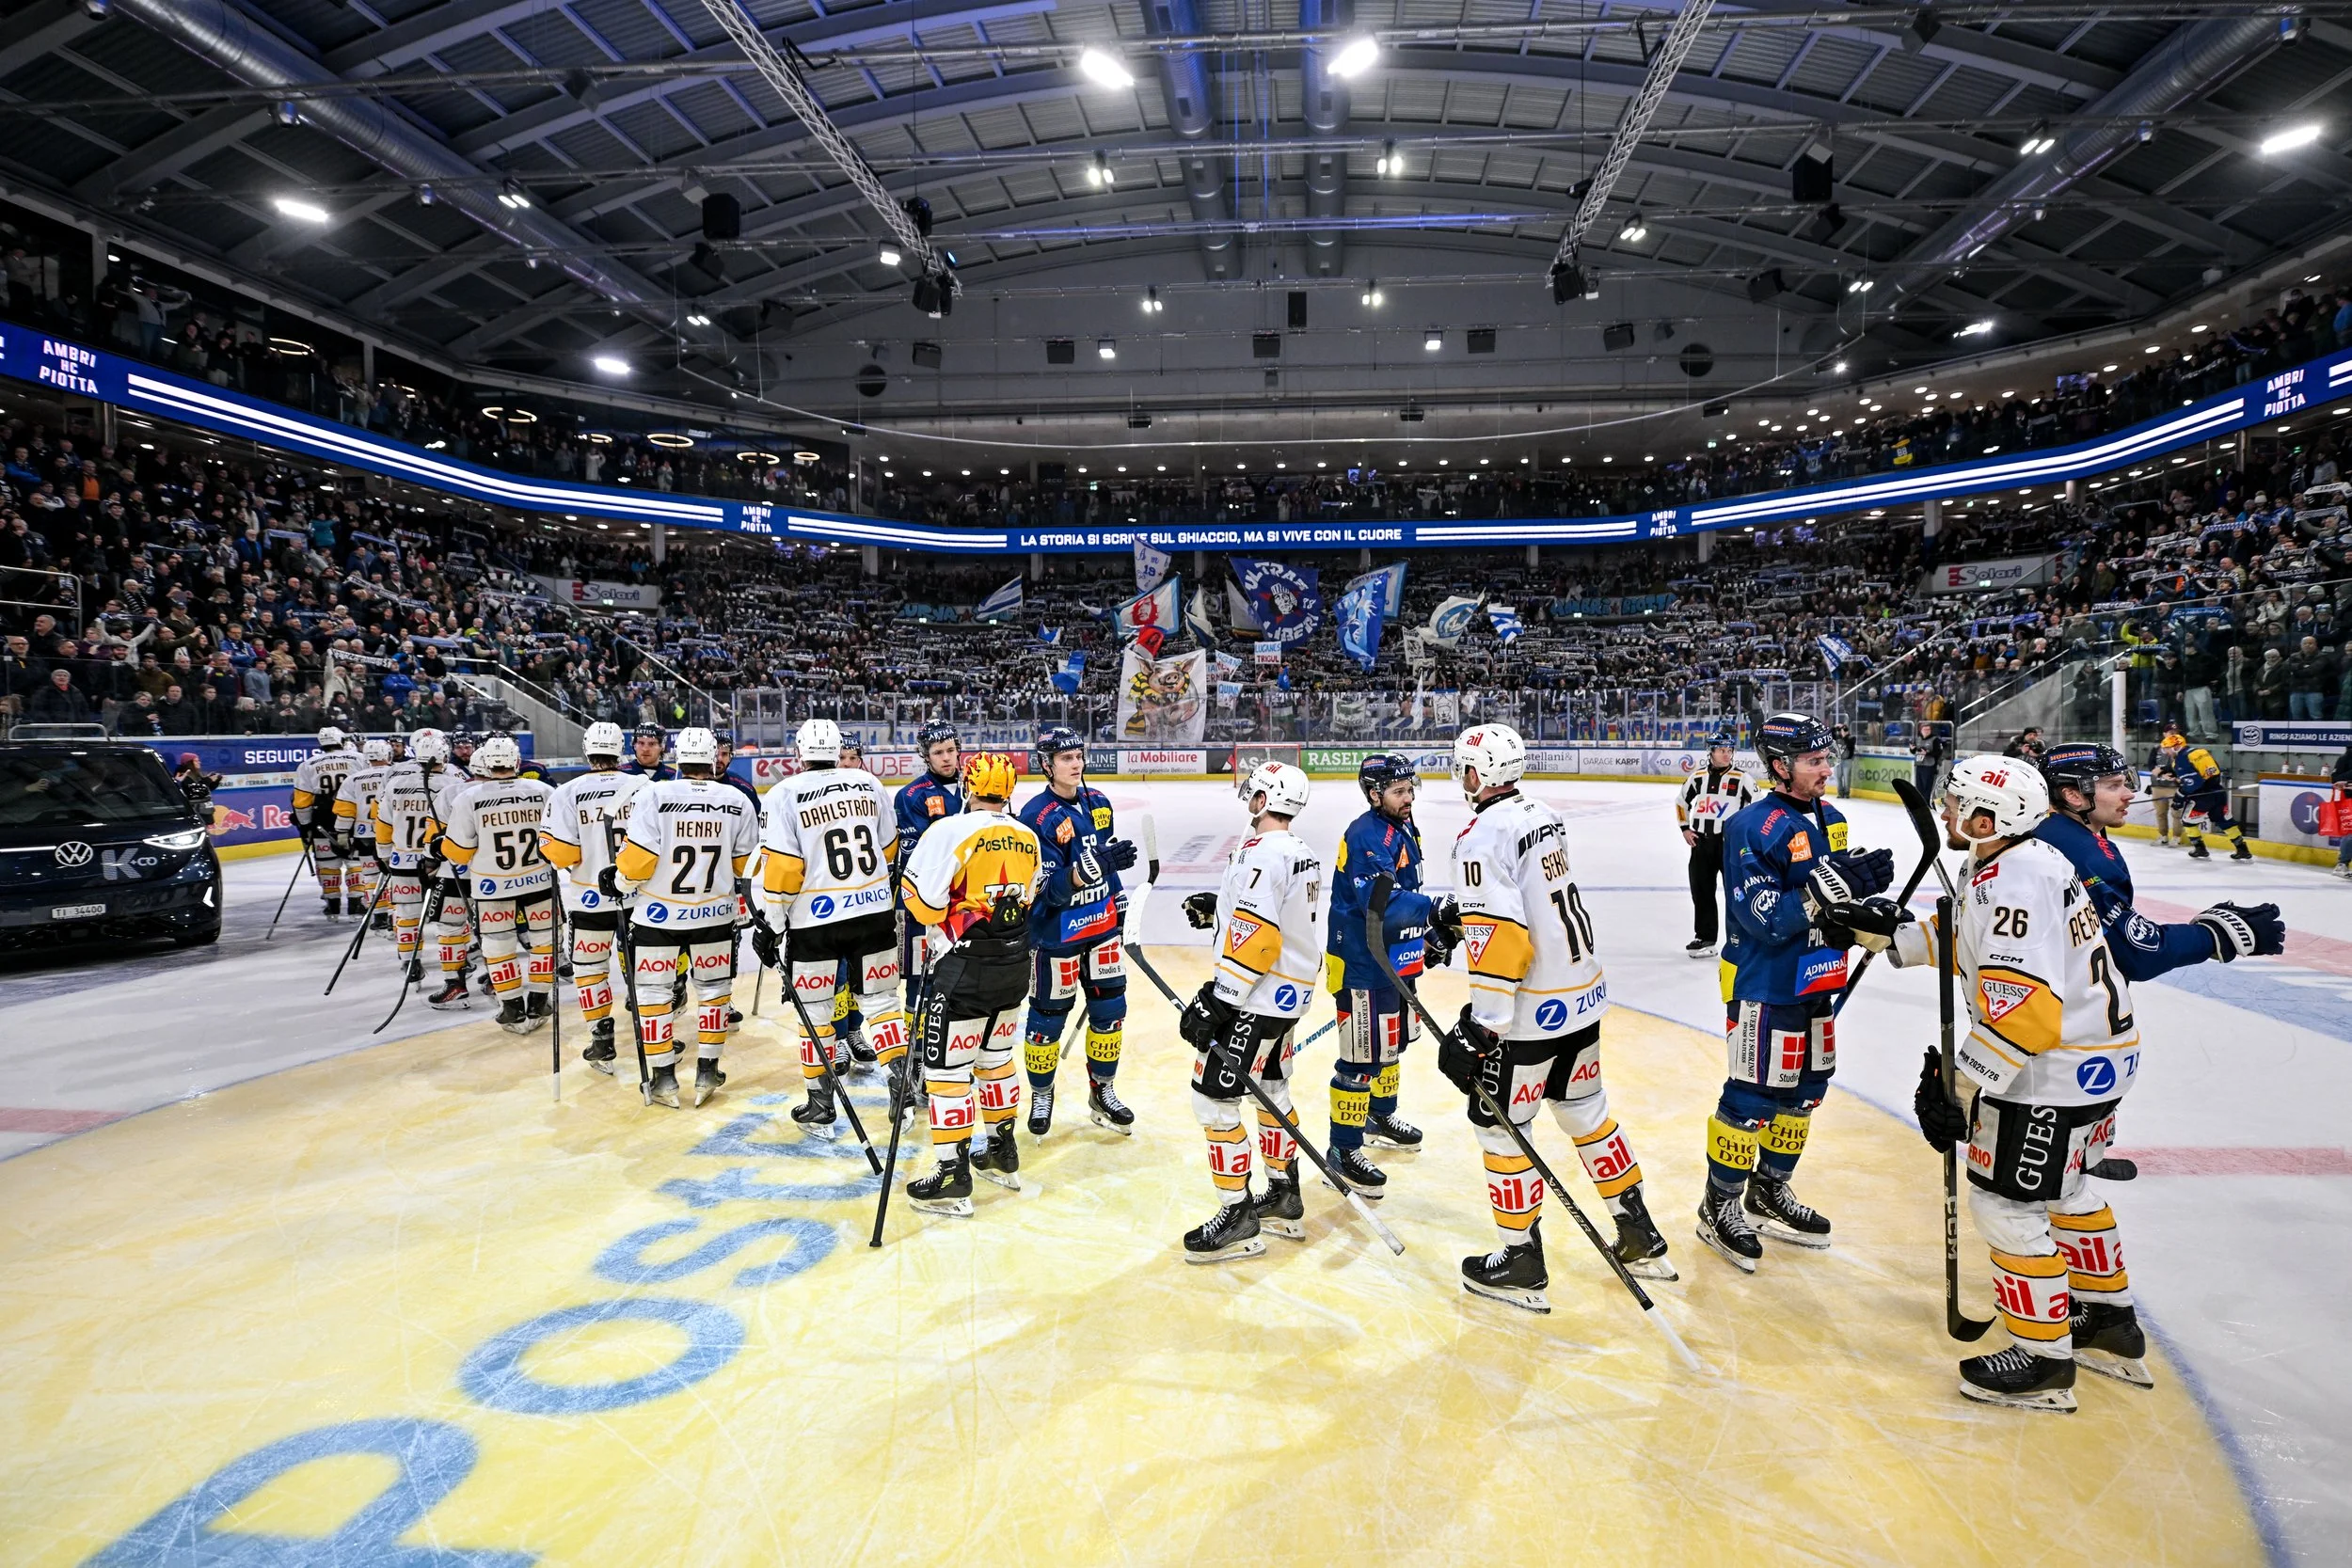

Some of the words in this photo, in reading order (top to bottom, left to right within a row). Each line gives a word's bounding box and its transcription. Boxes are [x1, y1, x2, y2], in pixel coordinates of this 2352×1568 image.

[60, 359, 78, 374] HC
[40, 366, 98, 394] PIOTTA
[2278, 386, 2291, 400] HC
[2264, 393, 2306, 417] PIOTTA
[740, 520, 772, 533] PIOTTA
[1649, 525, 1677, 537] PIOTTA
[1021, 534, 1037, 546] LA
[1040, 533, 1085, 546] STORIA
[1087, 533, 1100, 546] SI
[1151, 531, 1175, 545] SUL
[1180, 531, 1241, 546] GHIACCIO,
[1244, 530, 1263, 543] MA
[1267, 530, 1279, 543] SI
[1282, 529, 1311, 542] VIVE
[1313, 529, 1342, 542] CON
[1344, 529, 1356, 541] IL
[1358, 528, 1402, 541] CUORE
[1466, 733, 1484, 747] ail
[1127, 751, 1139, 763] la
[1140, 751, 1198, 763] Mobiliare
[1582, 757, 1614, 767] GARAGE
[1615, 756, 1641, 767] KARPF
[315, 762, 348, 774] PERLINI
[1128, 767, 1148, 775] Agenzia
[1264, 762, 1281, 775] ail
[1696, 797, 1729, 818] sky
[1975, 796, 1999, 806] CCM
[262, 804, 293, 831] Re
[482, 809, 541, 828] PELTONEN
[800, 796, 878, 829] DAHLSTRÖM
[676, 821, 722, 838] HENRY
[493, 828, 539, 871] 52
[823, 824, 878, 881] 63
[671, 845, 723, 895] 27
[1248, 867, 1263, 890] 7
[1462, 861, 1482, 888] 10
[393, 884, 421, 895] AON
[842, 886, 891, 909] ZURICH
[55, 907, 66, 918] TI
[73, 904, 103, 916] 34400
[676, 903, 734, 921] ZURICH
[1238, 898, 1258, 909] CCM
[481, 910, 515, 923] AON
[1230, 917, 1255, 933] GUESS
[1550, 881, 1595, 966] 10
[1993, 906, 2028, 939] 26
[575, 940, 612, 954] AON
[529, 956, 554, 974] ail
[637, 958, 677, 973] AON
[694, 953, 730, 969] AON
[1989, 952, 2025, 964] CCM
[491, 961, 516, 984] ail
[865, 960, 898, 981] AON
[793, 974, 835, 990] AON
[1983, 981, 2025, 998] GUESS
[698, 1008, 721, 1031] ail
[872, 1022, 902, 1052] ail
[948, 1032, 984, 1052] AON
[1968, 1056, 2000, 1082] 2025/26
[1593, 1134, 1632, 1180] ail
[2015, 1104, 2058, 1192] GUES
[1550, 1187, 1592, 1233] BAUER
[1945, 1195, 1958, 1260] CCM
[1489, 1270, 1511, 1281] BAUER
